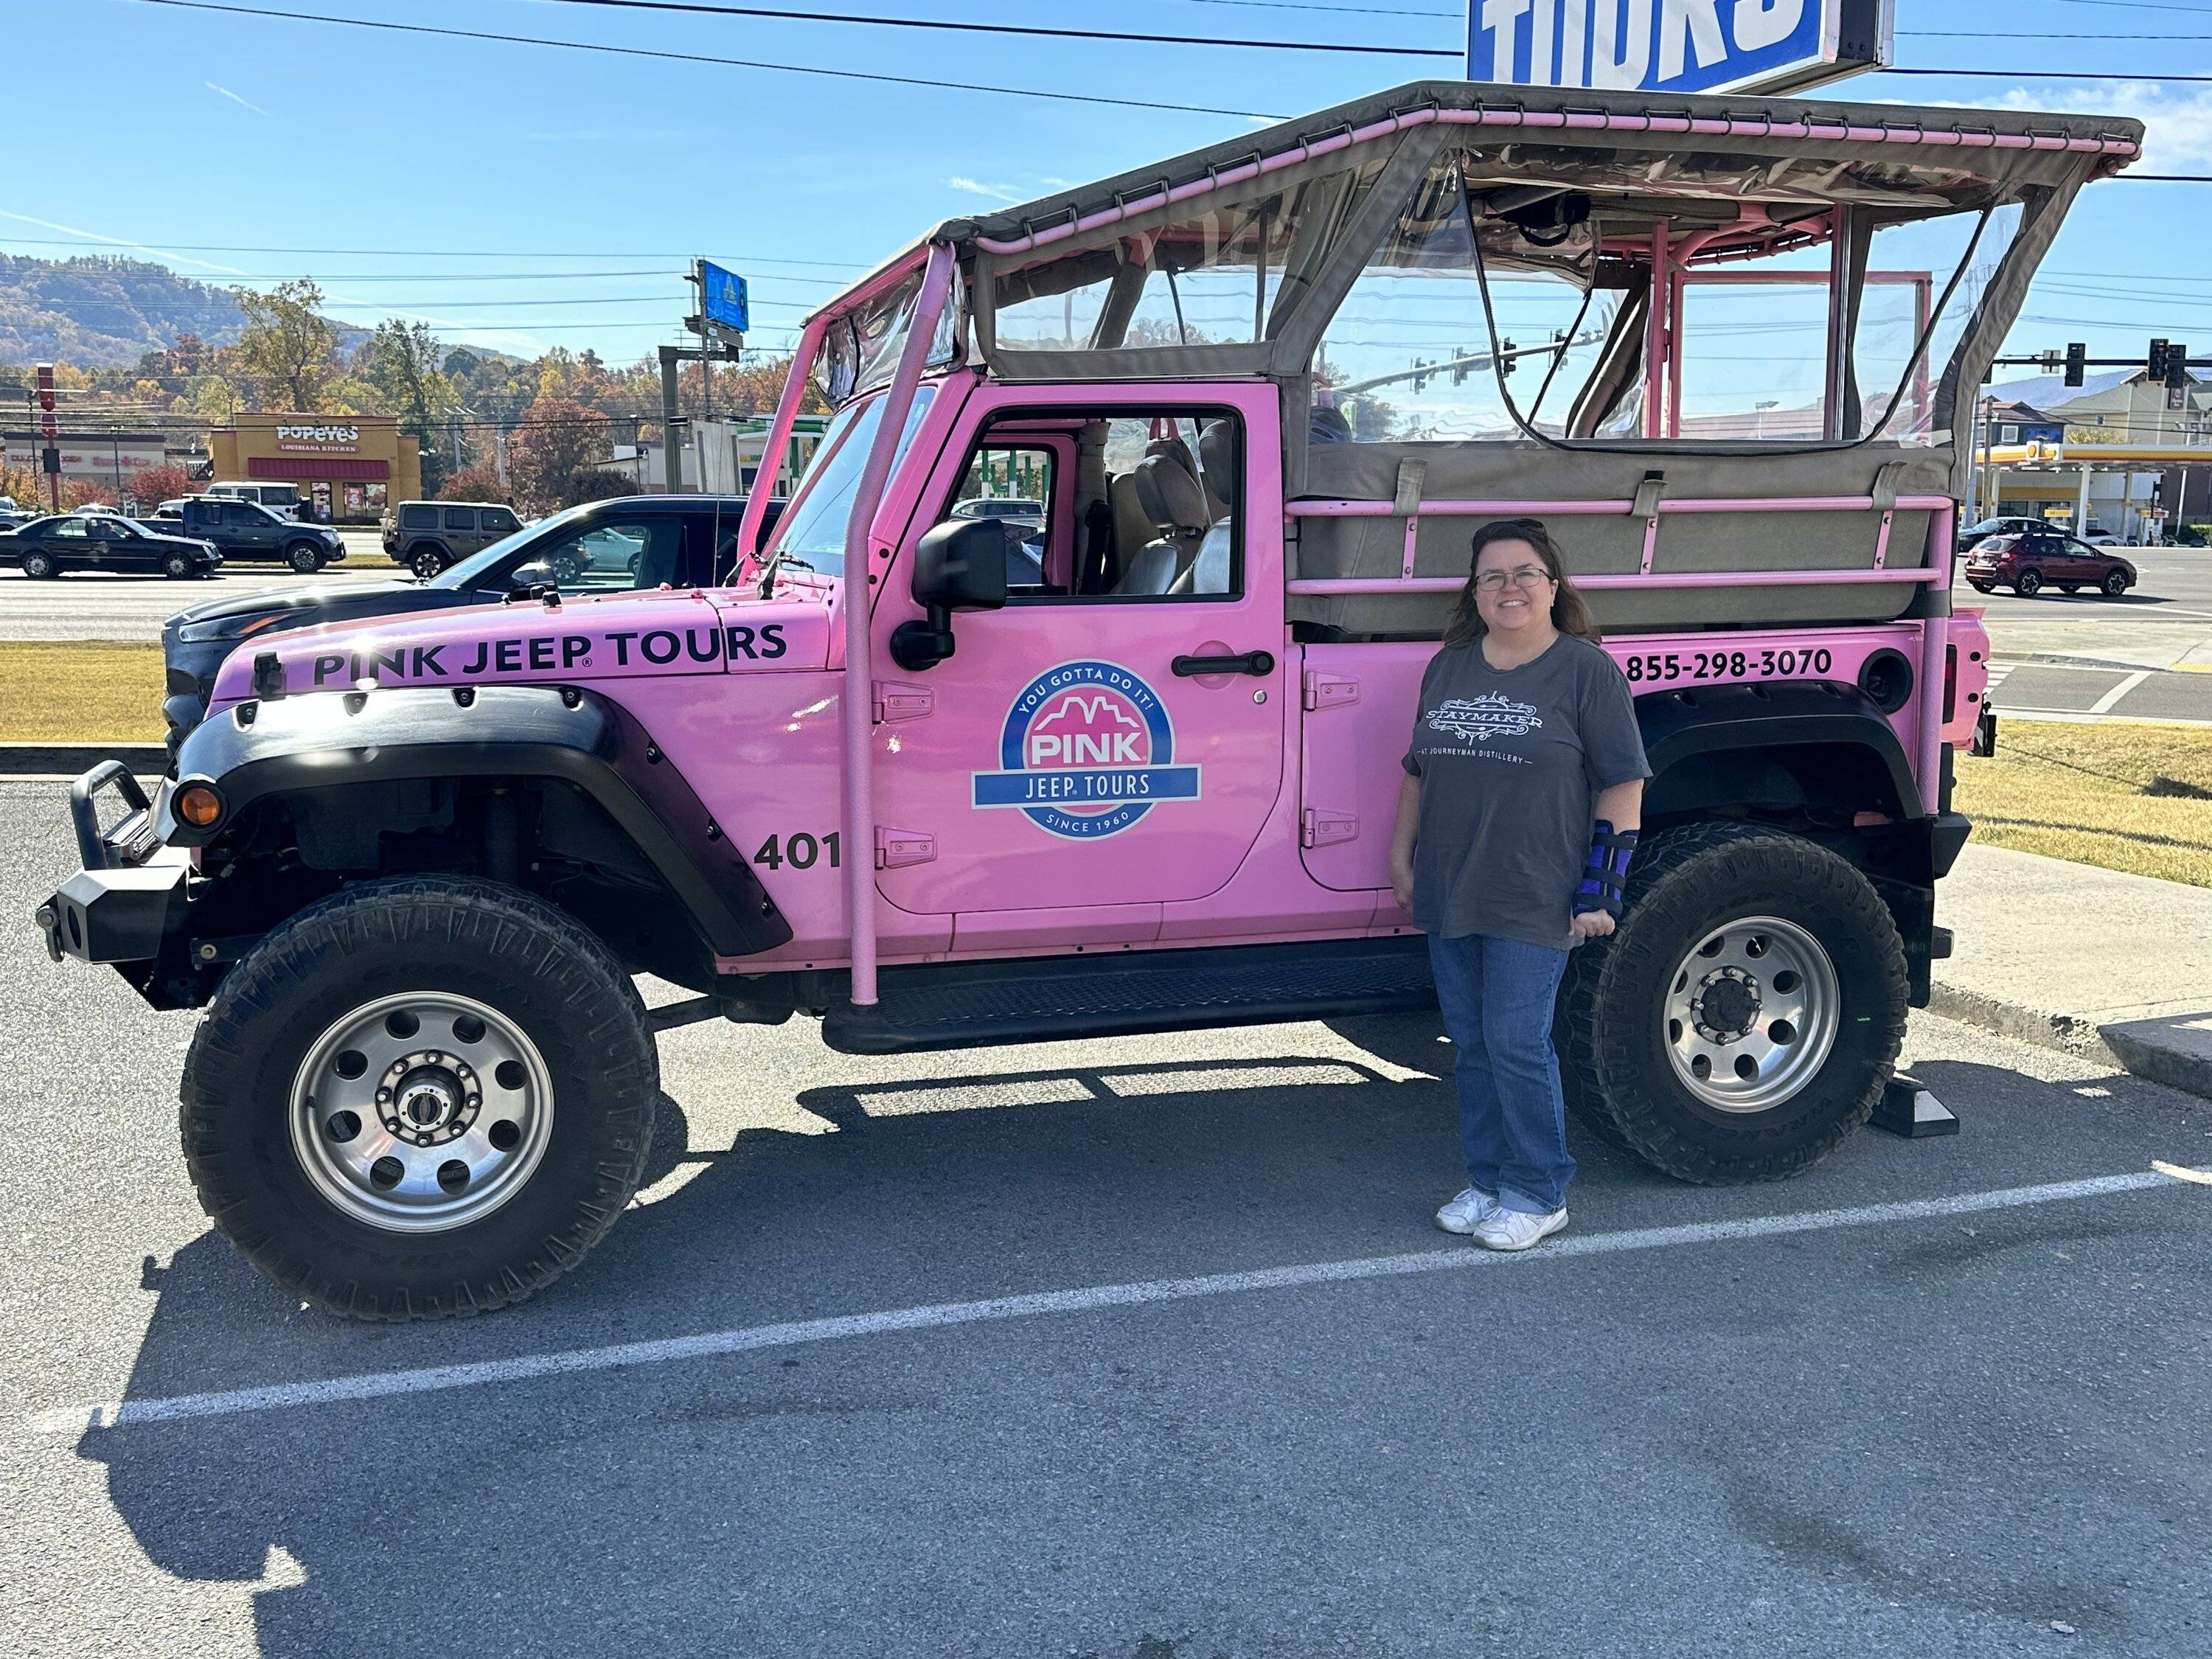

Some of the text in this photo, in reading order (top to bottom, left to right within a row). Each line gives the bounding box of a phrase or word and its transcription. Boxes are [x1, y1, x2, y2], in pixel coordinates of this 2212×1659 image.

[313, 625, 787, 686] PINK JEEP TOURS
[1627, 649, 1832, 681] 855-298-3070
[1018, 667, 1155, 714] YOU GOTTA DO IT!
[1425, 710, 1543, 728] STAYMAKER
[1032, 732, 1142, 765] PINK
[1429, 748, 1475, 757] JOURNEYMAN
[1478, 750, 1523, 764] DISTILLERY
[1026, 774, 1150, 799] JEEP TOURS
[1046, 811, 1129, 832] SINCE 1960
[754, 832, 840, 870] 401
